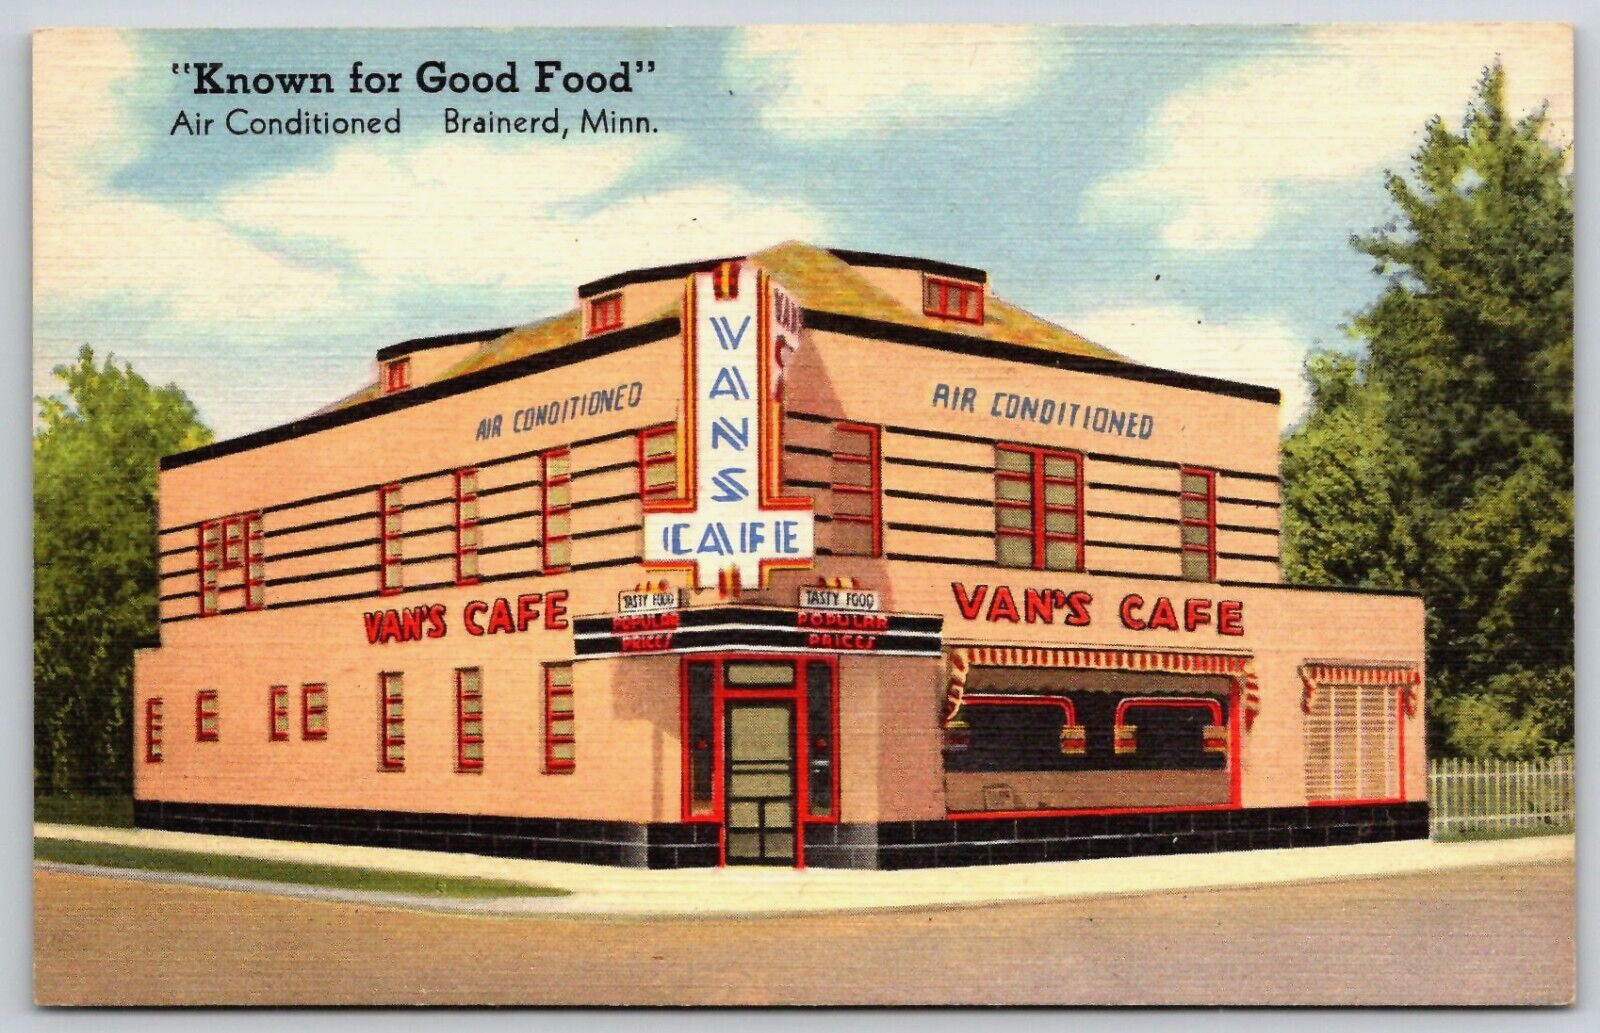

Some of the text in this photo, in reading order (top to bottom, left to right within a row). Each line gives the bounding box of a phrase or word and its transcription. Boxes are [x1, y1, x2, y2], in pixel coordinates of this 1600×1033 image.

[475, 381, 643, 442] AIR CONDITIONED
[709, 314, 753, 503] VANS
[932, 383, 1154, 440] AIR CONDITIONED
[663, 520, 800, 556] CAFE
[364, 589, 569, 644] VAN'S CAFE
[623, 594, 649, 609] TASTY
[796, 611, 888, 631] POPULAR
[805, 590, 874, 609] TASTY FOOD
[951, 582, 1246, 637] VAN'S CAFE
[807, 633, 876, 650] PRICES
